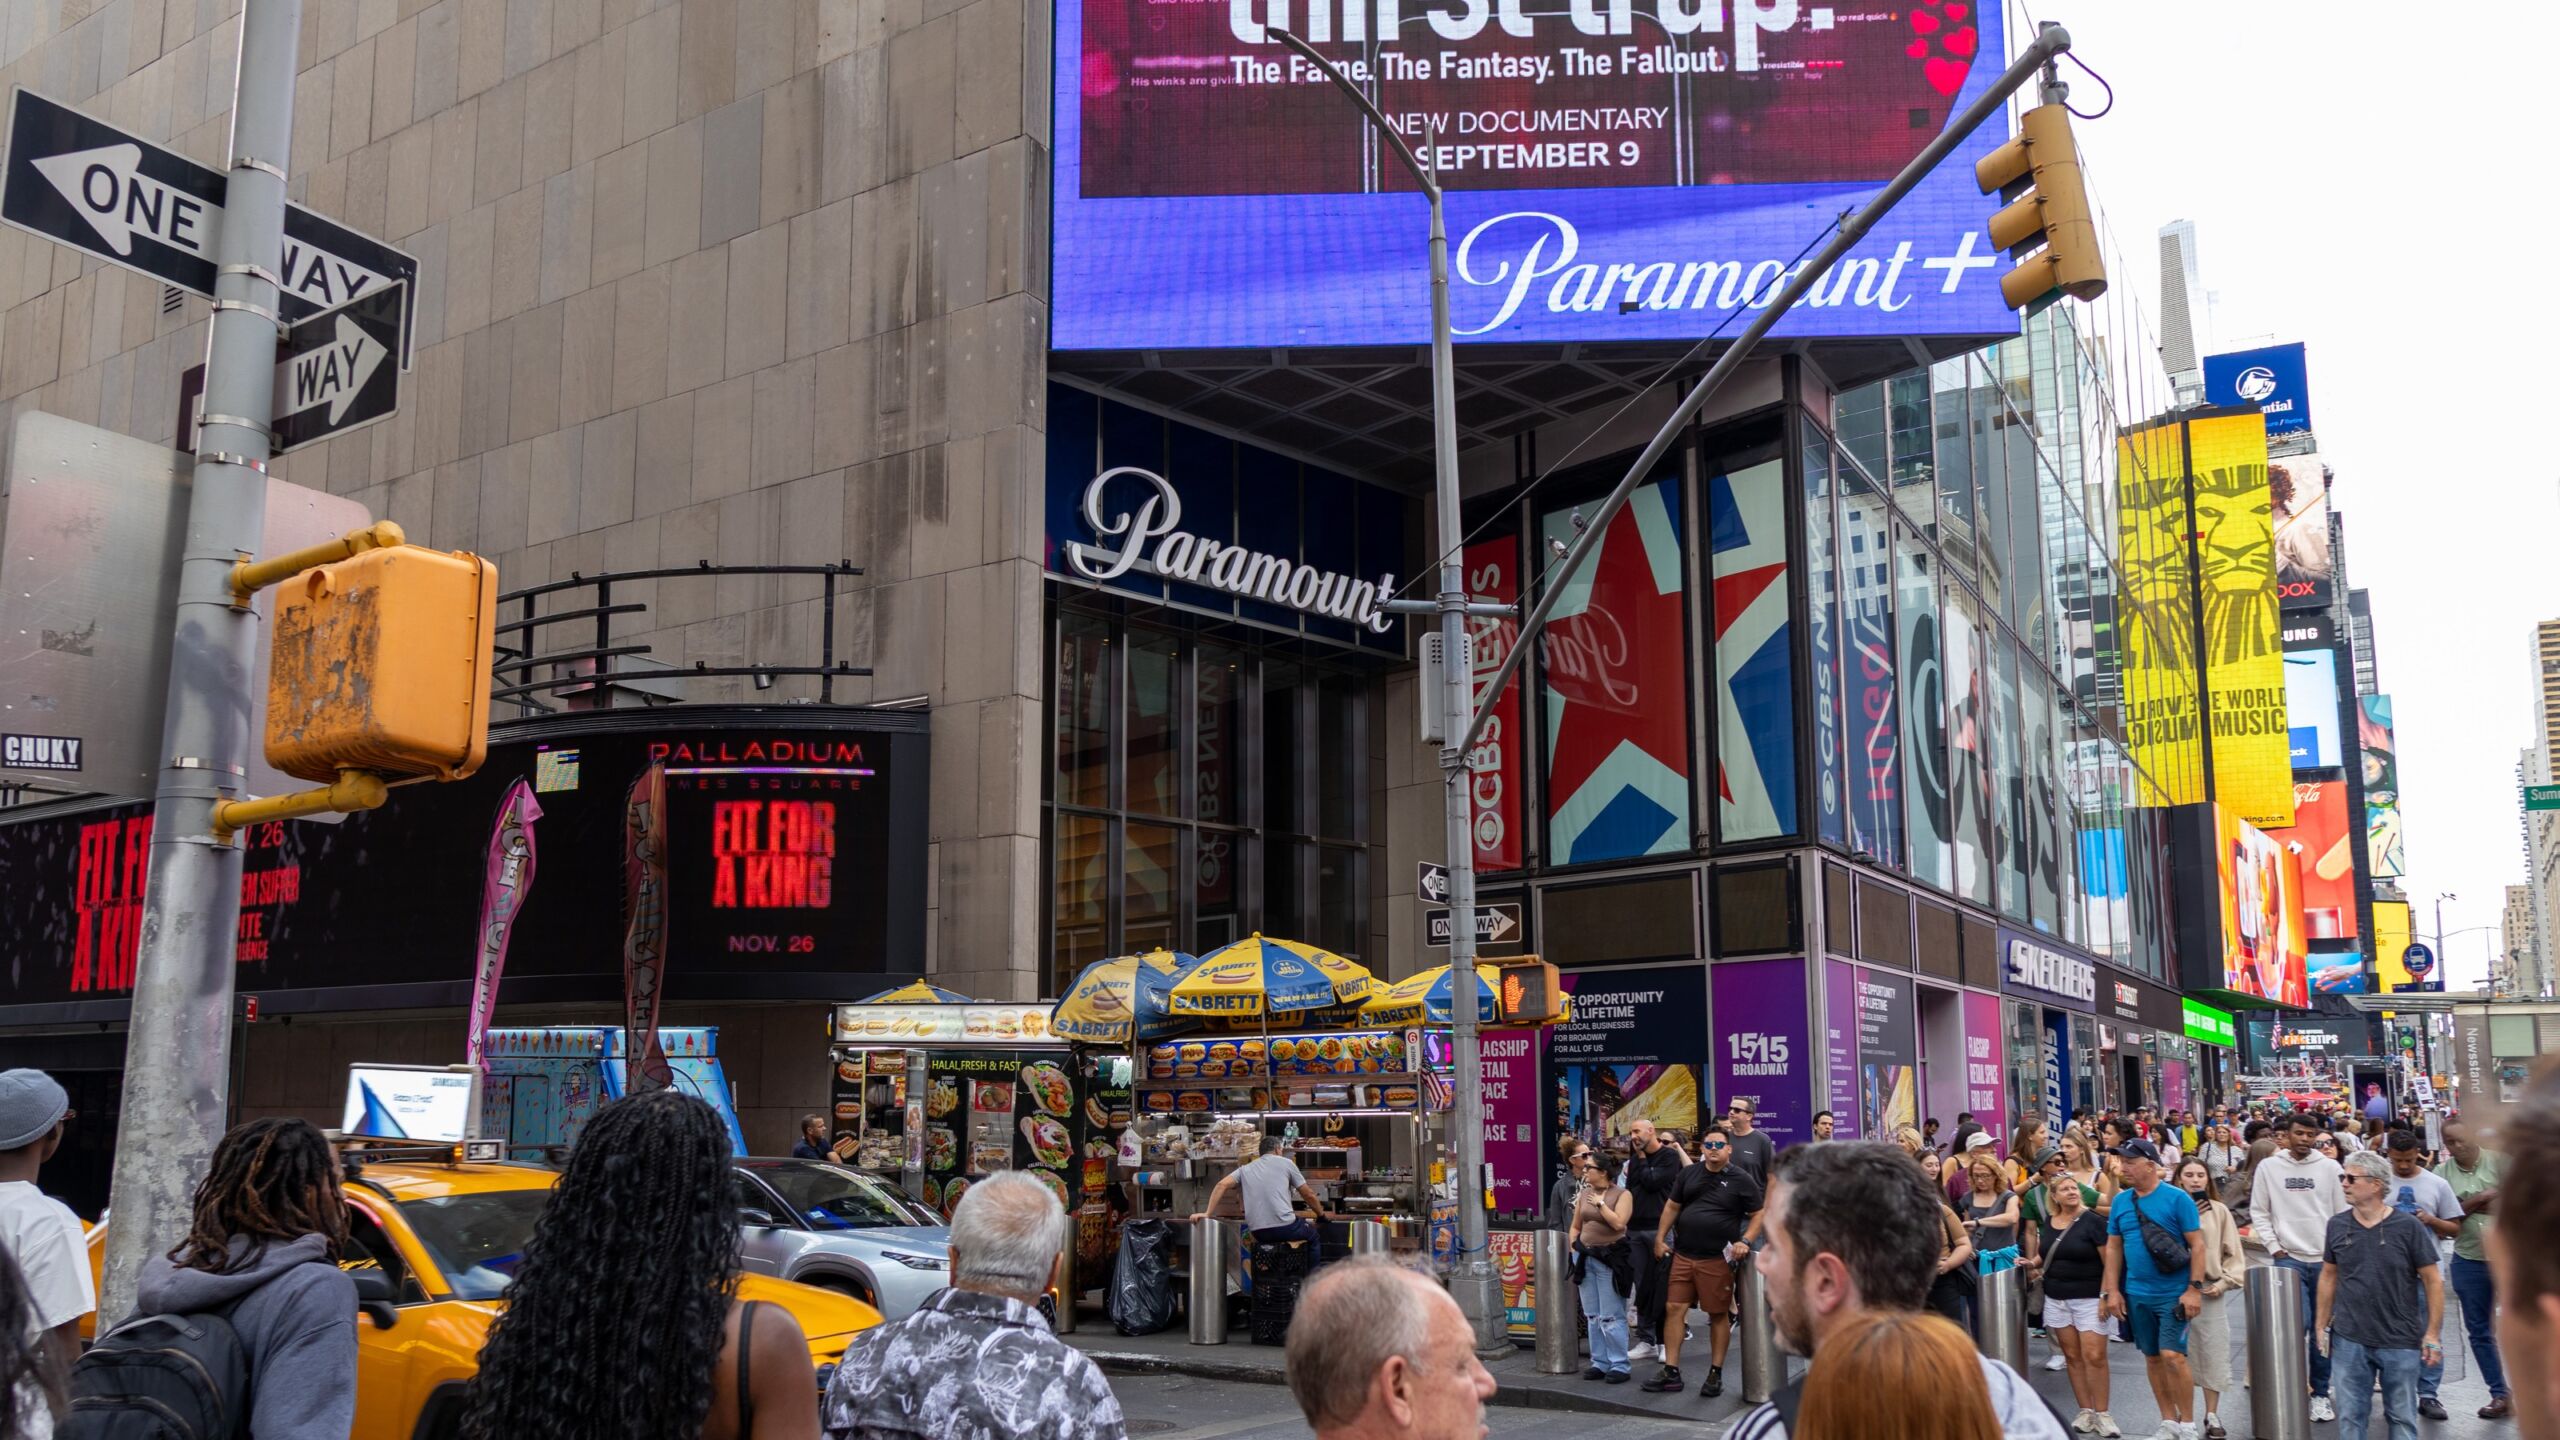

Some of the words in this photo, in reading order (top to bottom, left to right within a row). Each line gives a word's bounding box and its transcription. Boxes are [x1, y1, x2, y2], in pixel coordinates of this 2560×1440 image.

[1230, 56, 1281, 84] The
[1380, 52, 1431, 80] The
[1440, 50, 1555, 84] Fantasy.
[1560, 47, 1611, 76] The
[1621, 45, 1726, 75] Fallout.
[1763, 61, 1805, 69] irresistible
[1131, 77, 1150, 87] His
[1153, 77, 1186, 86] winks
[1189, 78, 1207, 86] are
[1386, 112, 1449, 135] NEW
[1459, 107, 1669, 133] DOCUMENTARY
[1415, 142, 1610, 171] SEPTEMBER
[1619, 141, 1640, 166] 9
[82, 163, 202, 251] ONE
[297, 338, 365, 407] WAY
[2261, 399, 2293, 414] ntial
[1067, 466, 1396, 633] Paramount
[1816, 661, 1835, 767] CBS
[2213, 707, 2288, 737] MUSIC
[5, 736, 79, 764] CHUKY
[650, 742, 864, 763] PALLADIUM
[1472, 715, 1502, 809] CBS
[666, 779, 728, 790] IMES
[750, 779, 861, 790] SQUARE
[261, 821, 285, 849] 26
[713, 801, 763, 858] FIT
[769, 801, 836, 858] FOR
[76, 820, 121, 913] FIT
[713, 855, 737, 908] A
[745, 855, 832, 908] KING
[1428, 876, 1444, 892] ONE
[1435, 920, 1451, 935] ON
[1476, 916, 1504, 932] WAY
[70, 907, 93, 992] A
[729, 935, 781, 952] NOV.
[789, 935, 815, 952] 26
[1198, 961, 1258, 978] SABRETT
[2009, 938, 2096, 1002] SKECHERS
[1079, 981, 1131, 999] SABRETT
[1578, 990, 1664, 1006] OPPORTUNITY
[1174, 994, 1260, 1010] SABRETT
[1360, 1005, 1422, 1025] SABRETT
[1582, 1006, 1635, 1019] LIFETIME
[1056, 1019, 1131, 1037] SABRETT
[1554, 1023, 1568, 1031] FOR
[1568, 1022, 1591, 1030] LOCAL
[1592, 1021, 1635, 1030] BUSINESSES
[1408, 1032, 1417, 1043] 6
[1554, 1034, 1568, 1042] FOR
[1569, 1033, 1607, 1042] BROADWAY
[1480, 1040, 1529, 1057] LAGSHIP
[1593, 1044, 1604, 1052] US
[989, 1060, 998, 1070] &
[1000, 1060, 1021, 1071] FAST
[2466, 1027, 2483, 1094] Newsstand
[1480, 1061, 1511, 1078] ETAIL
[1732, 1063, 1788, 1076] BROADWAY
[1480, 1082, 1508, 1099] PACE
[1484, 1124, 1507, 1141] ASE
[1491, 1233, 1515, 1243] SOFT
[1511, 1242, 1534, 1254] CRE
[1511, 1310, 1530, 1321] WAY
